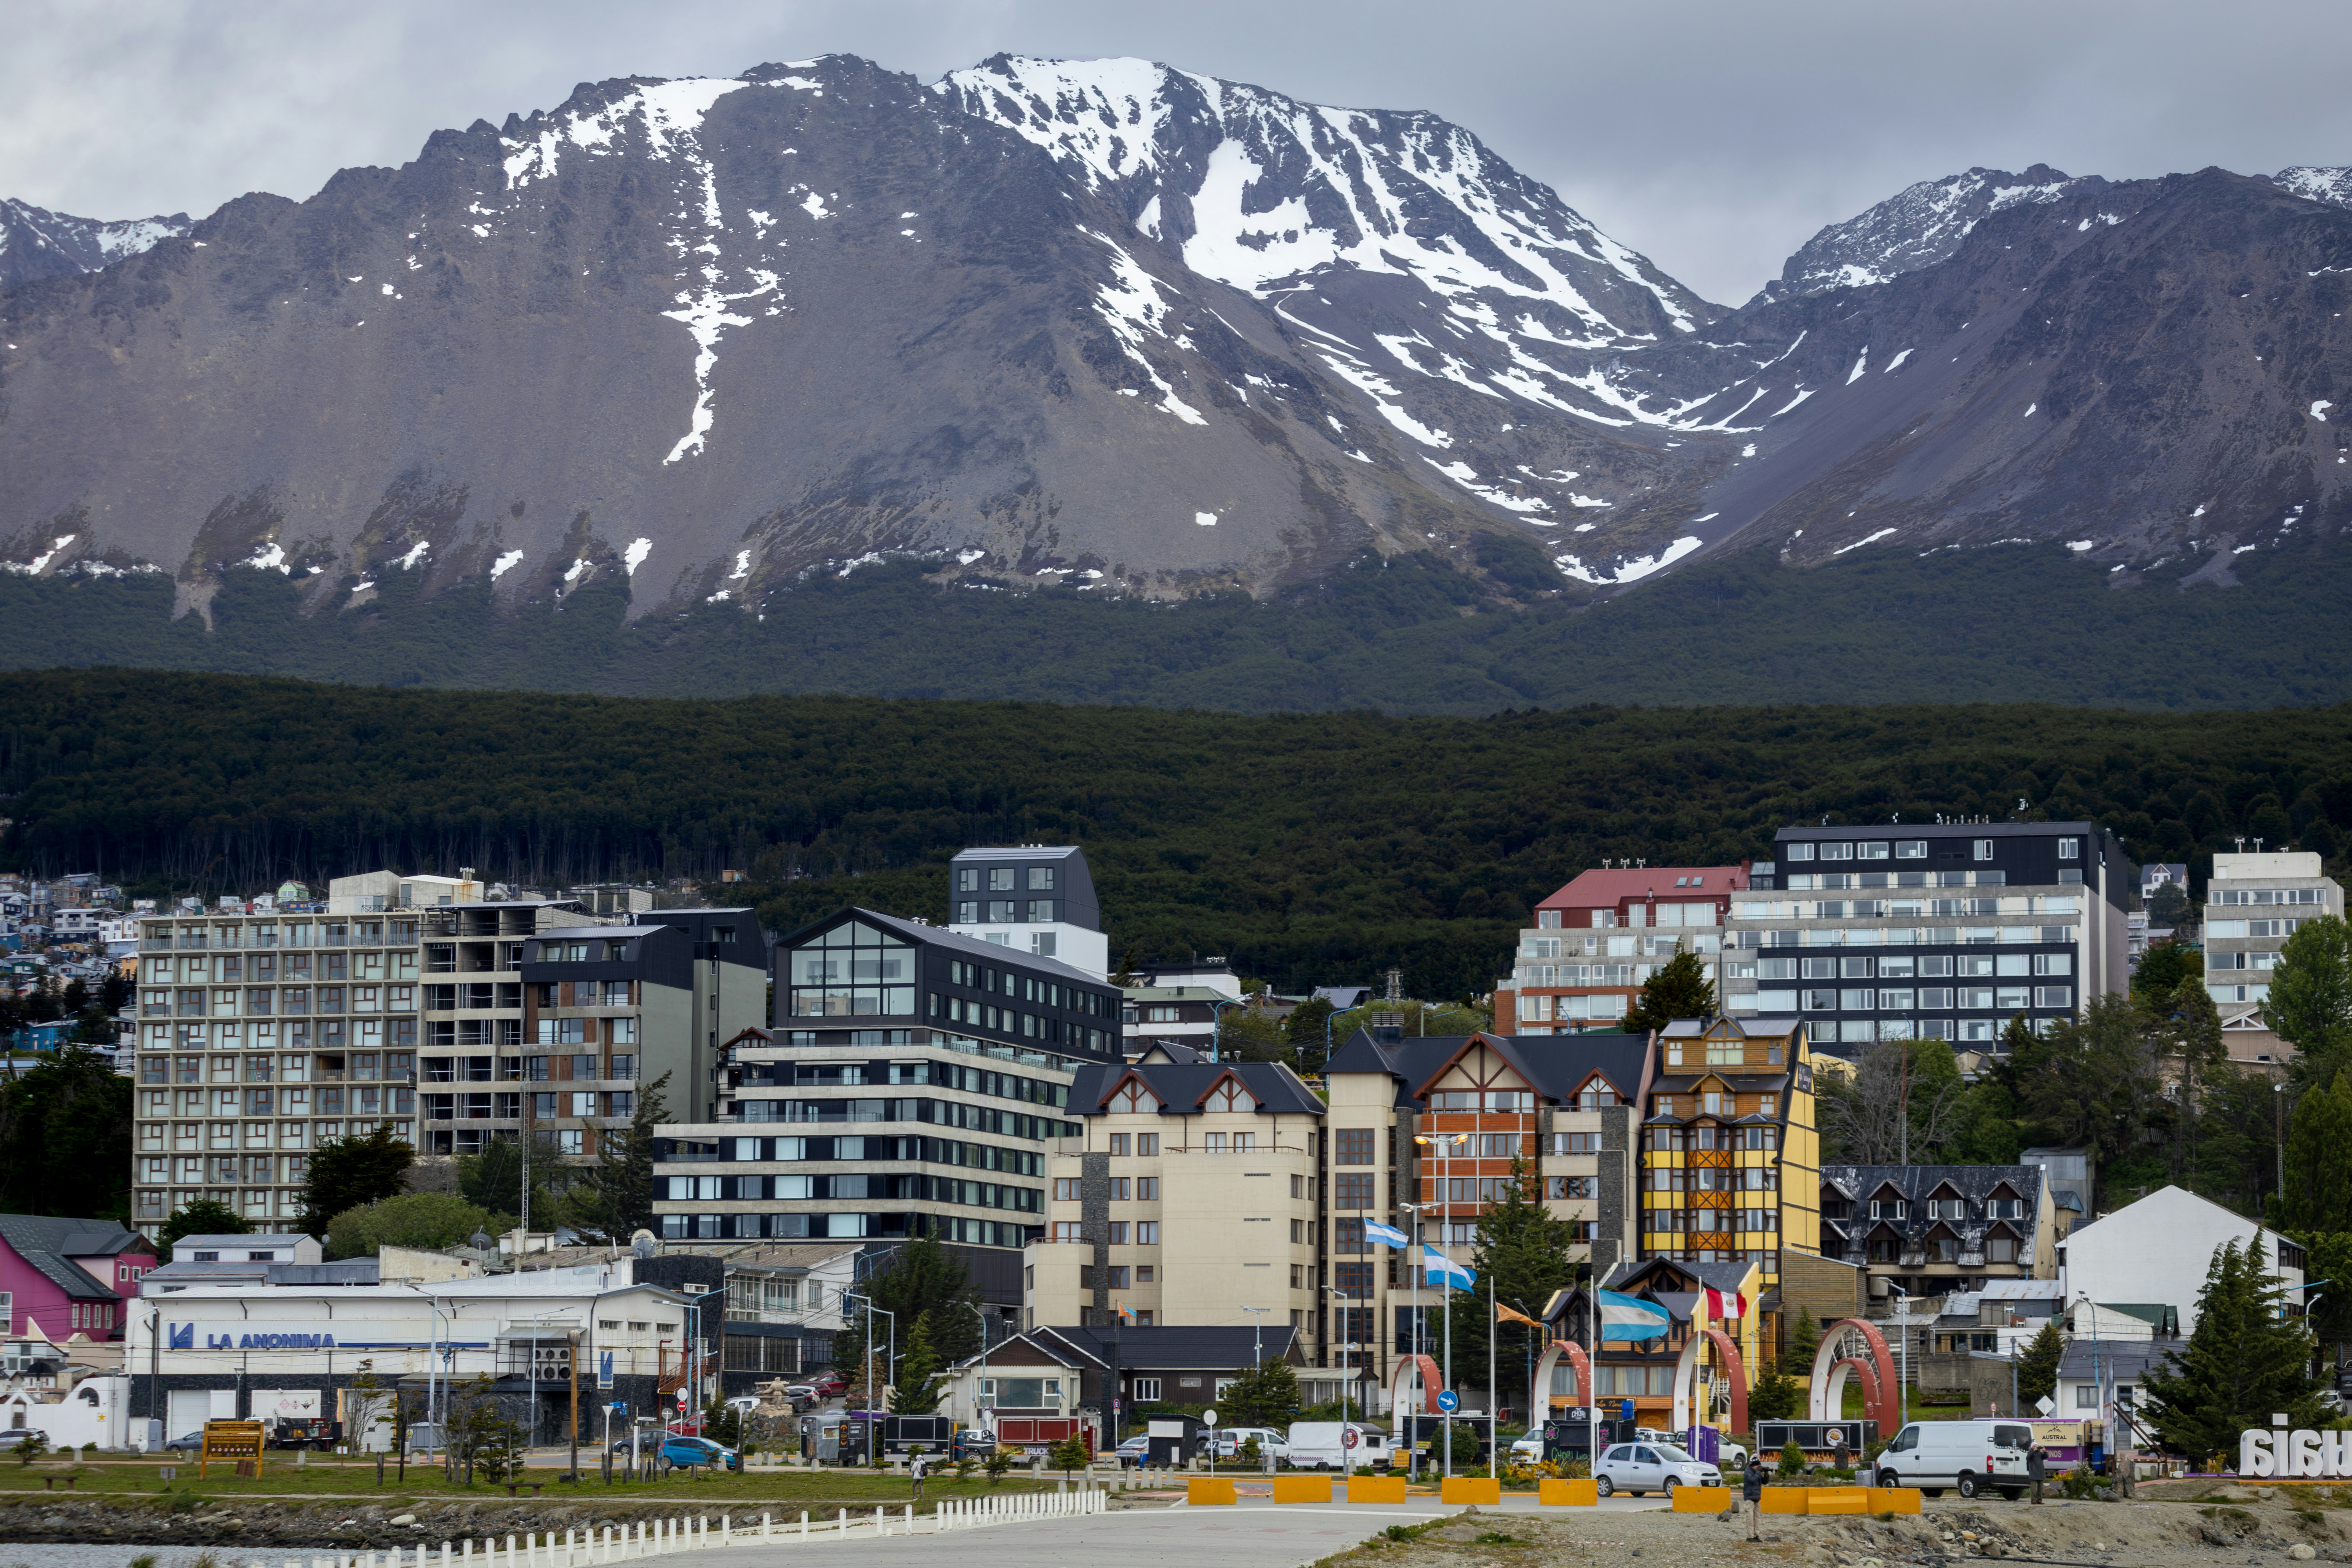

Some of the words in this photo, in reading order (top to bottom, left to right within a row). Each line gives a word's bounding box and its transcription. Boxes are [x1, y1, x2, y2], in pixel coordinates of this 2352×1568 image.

[208, 1334, 232, 1348] LA
[240, 1334, 335, 1348] ANONIMA
[1572, 1410, 1586, 1419] CHORI
[1023, 1447, 1049, 1455] TRUCK
